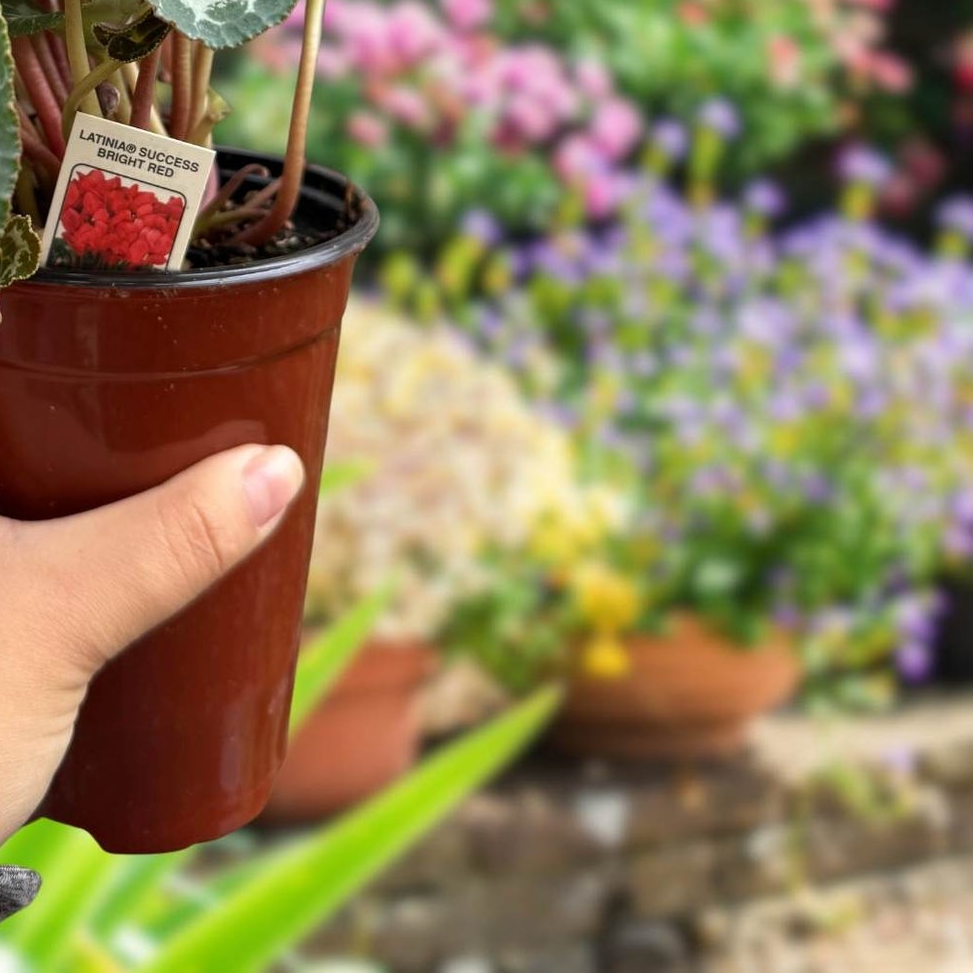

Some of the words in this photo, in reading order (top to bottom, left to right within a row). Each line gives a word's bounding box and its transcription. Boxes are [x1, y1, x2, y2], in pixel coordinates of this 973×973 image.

[79, 130, 136, 153] LATINIA®
[138, 147, 199, 172] SUCCESS
[97, 148, 145, 169] BRIGHT
[147, 163, 174, 177] RED
